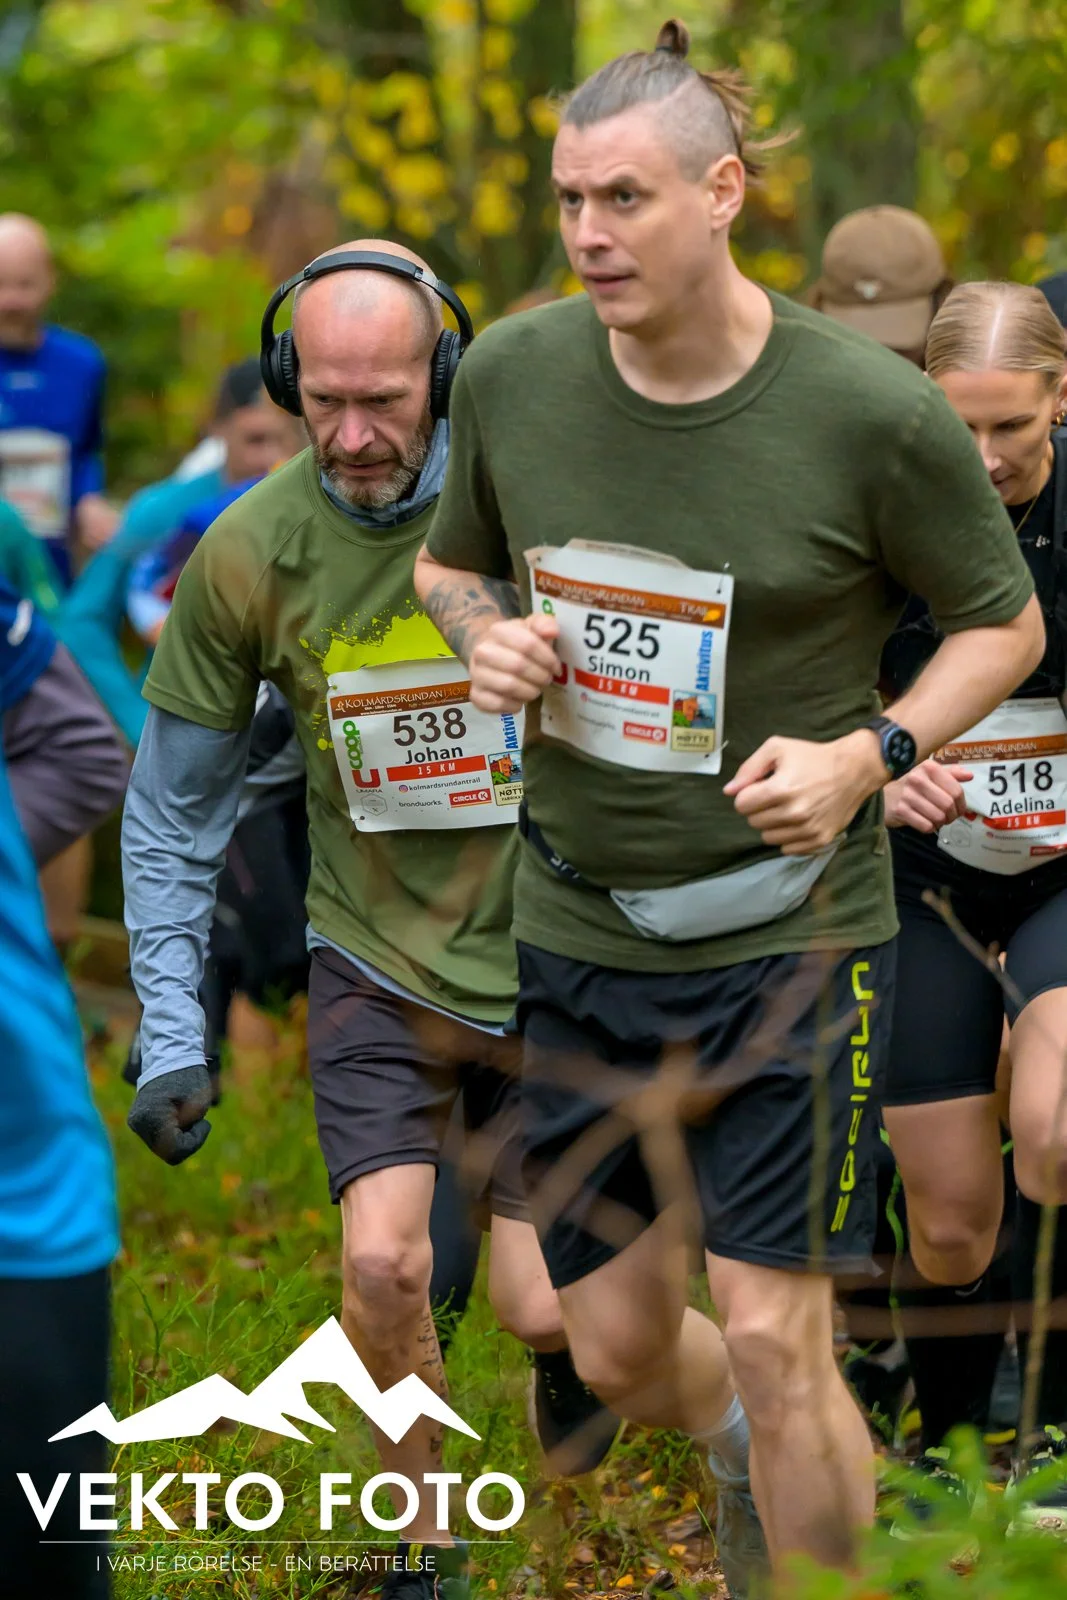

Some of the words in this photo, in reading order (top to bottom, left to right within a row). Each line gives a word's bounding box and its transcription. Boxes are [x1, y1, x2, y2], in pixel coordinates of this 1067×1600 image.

[583, 613, 660, 660] 525
[588, 655, 650, 682] Simon
[393, 708, 467, 746] 538
[343, 720, 362, 769] coop
[405, 746, 463, 764] Johan
[418, 765, 432, 776] 15
[440, 762, 456, 773] KM
[988, 761, 1053, 796] 518
[452, 793, 478, 803] CIRCLE
[989, 797, 1055, 818] Adelina
